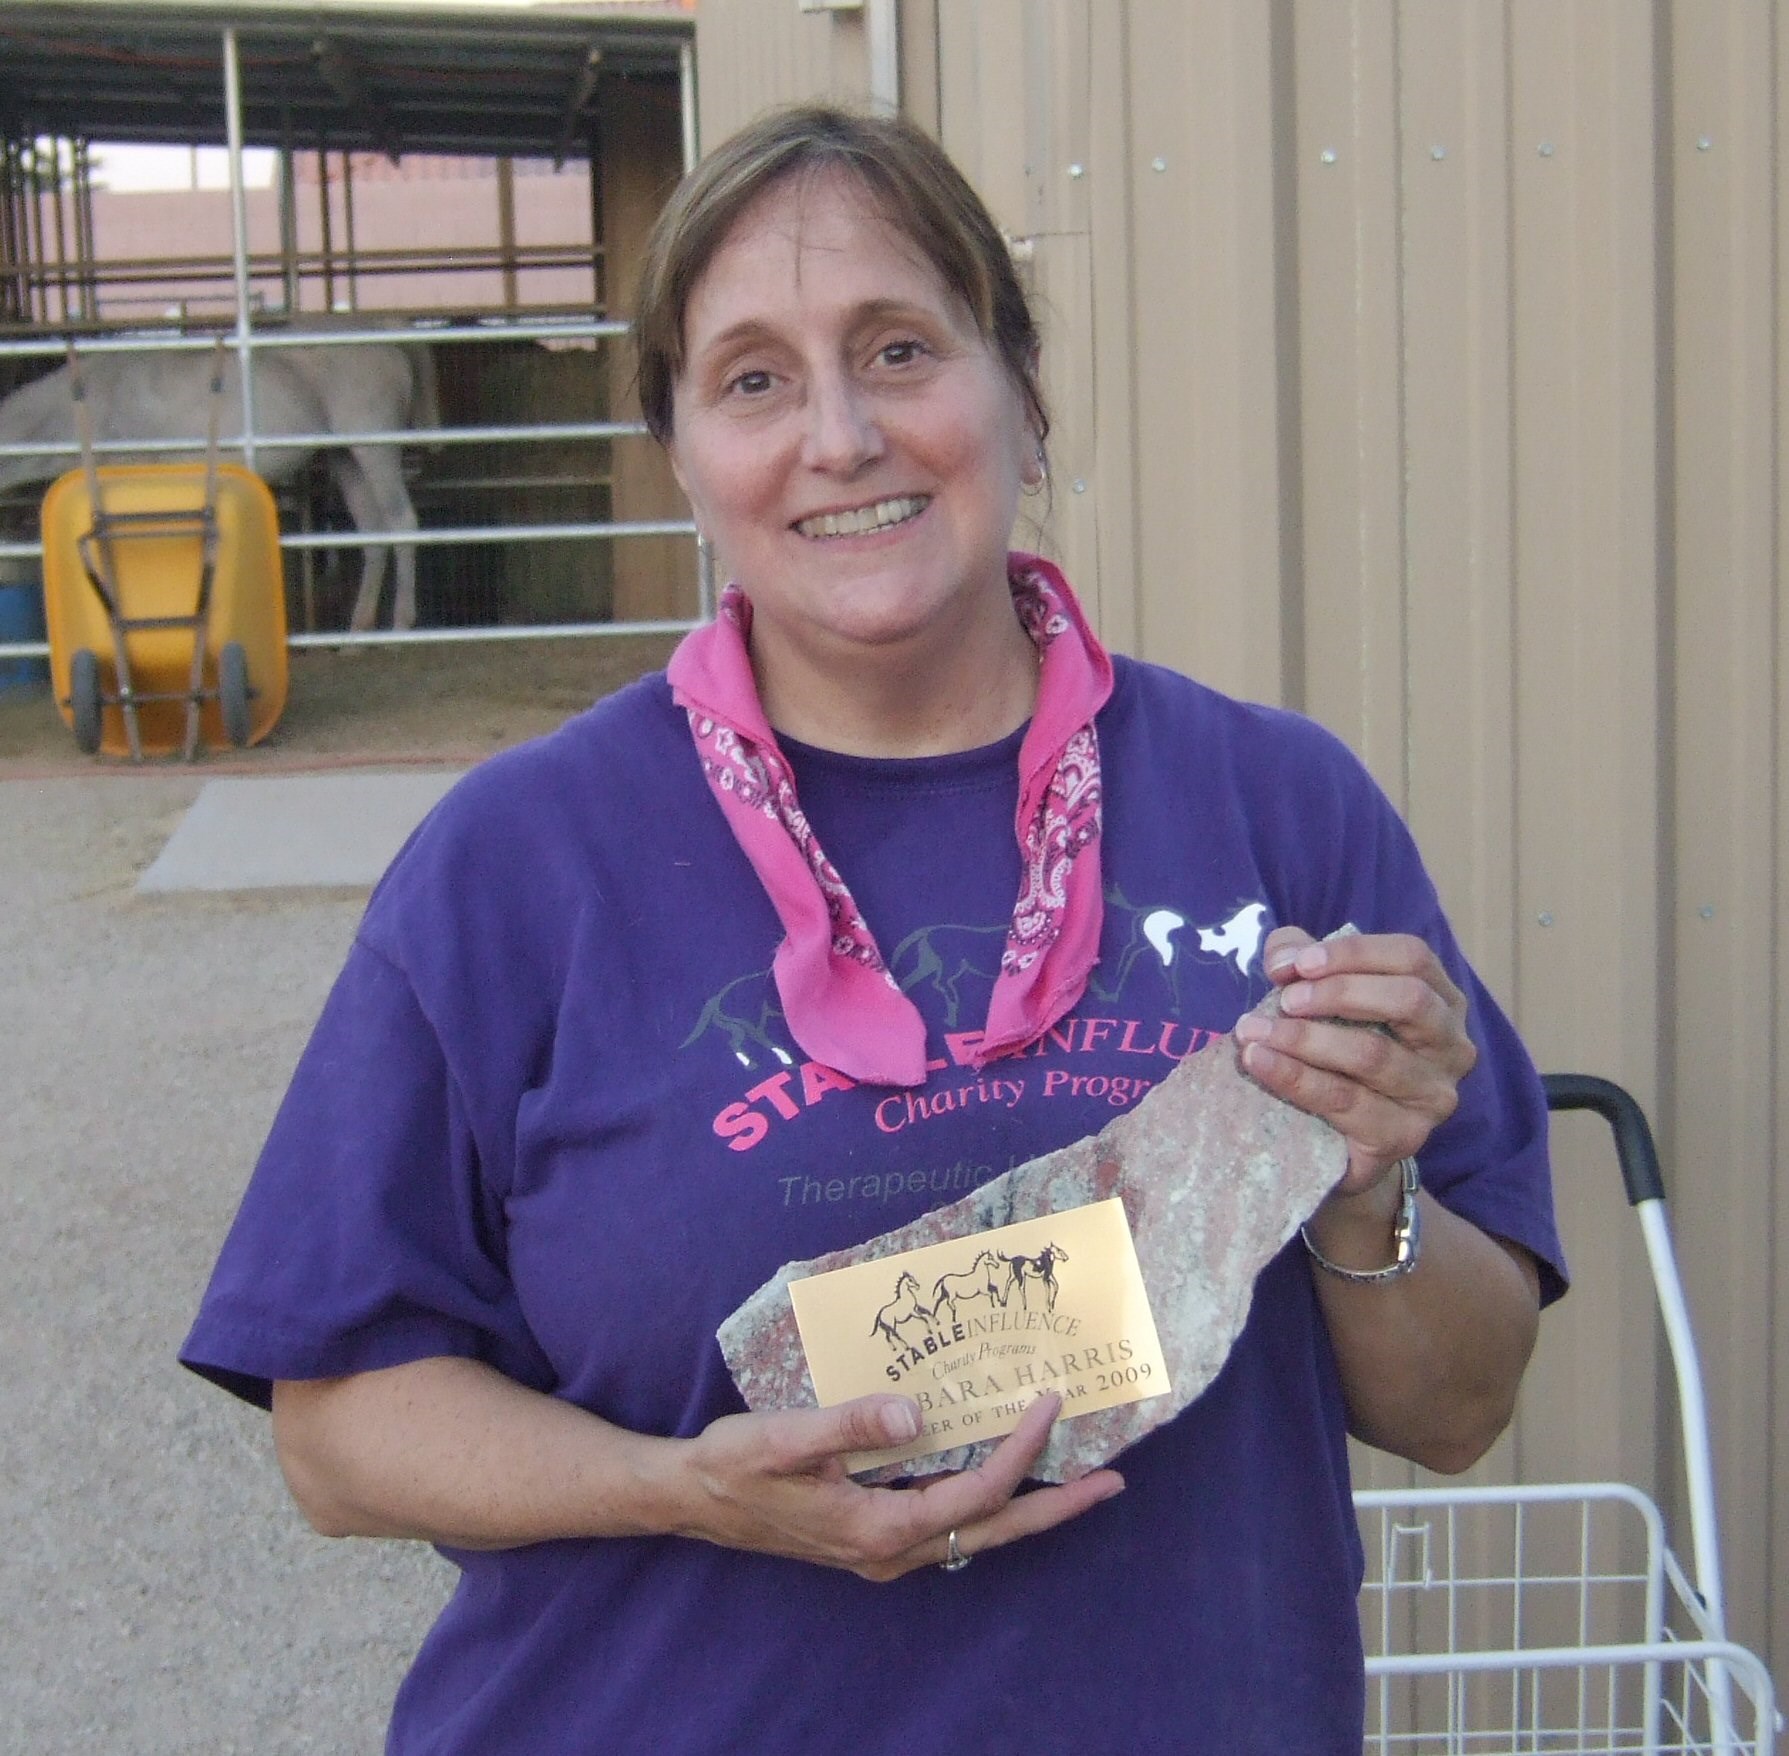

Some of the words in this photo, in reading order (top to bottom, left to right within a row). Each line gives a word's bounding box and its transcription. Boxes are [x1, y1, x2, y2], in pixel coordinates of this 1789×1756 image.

[713, 1030, 986, 1151] STAE
[874, 1078, 1025, 1133] Charity
[778, 1159, 993, 1205] Therapeutic
[885, 1323, 965, 1382] STABLE
[967, 1311, 1082, 1338] INFLUENCE
[915, 1375, 1004, 1412] BARA
[1015, 1338, 1134, 1386] HARRIS
[932, 1352, 977, 1381] Charity
[978, 1341, 1037, 1361] Programs
[961, 1411, 983, 1427] OF
[991, 1399, 1027, 1419] THE
[1035, 1384, 1088, 1401] YAR
[1096, 1362, 1153, 1392] 2009
